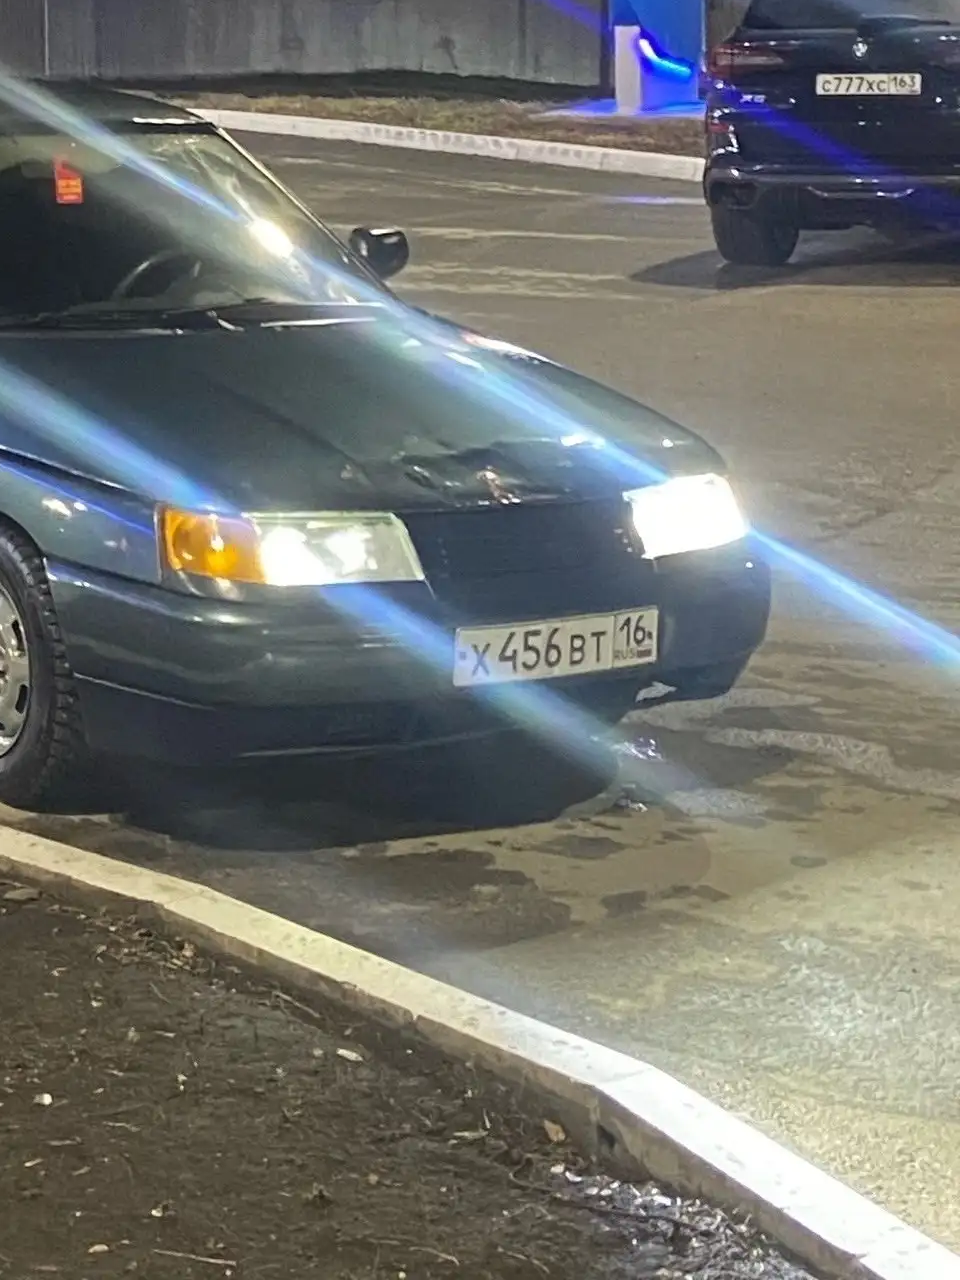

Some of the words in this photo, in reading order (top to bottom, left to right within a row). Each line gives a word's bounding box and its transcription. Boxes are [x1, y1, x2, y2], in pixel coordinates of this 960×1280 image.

[821, 76, 887, 93] С777ХС
[891, 75, 917, 88] 163
[470, 627, 607, 677] Х456ВТ
[618, 615, 646, 647] 16
[613, 648, 636, 660] RUS
